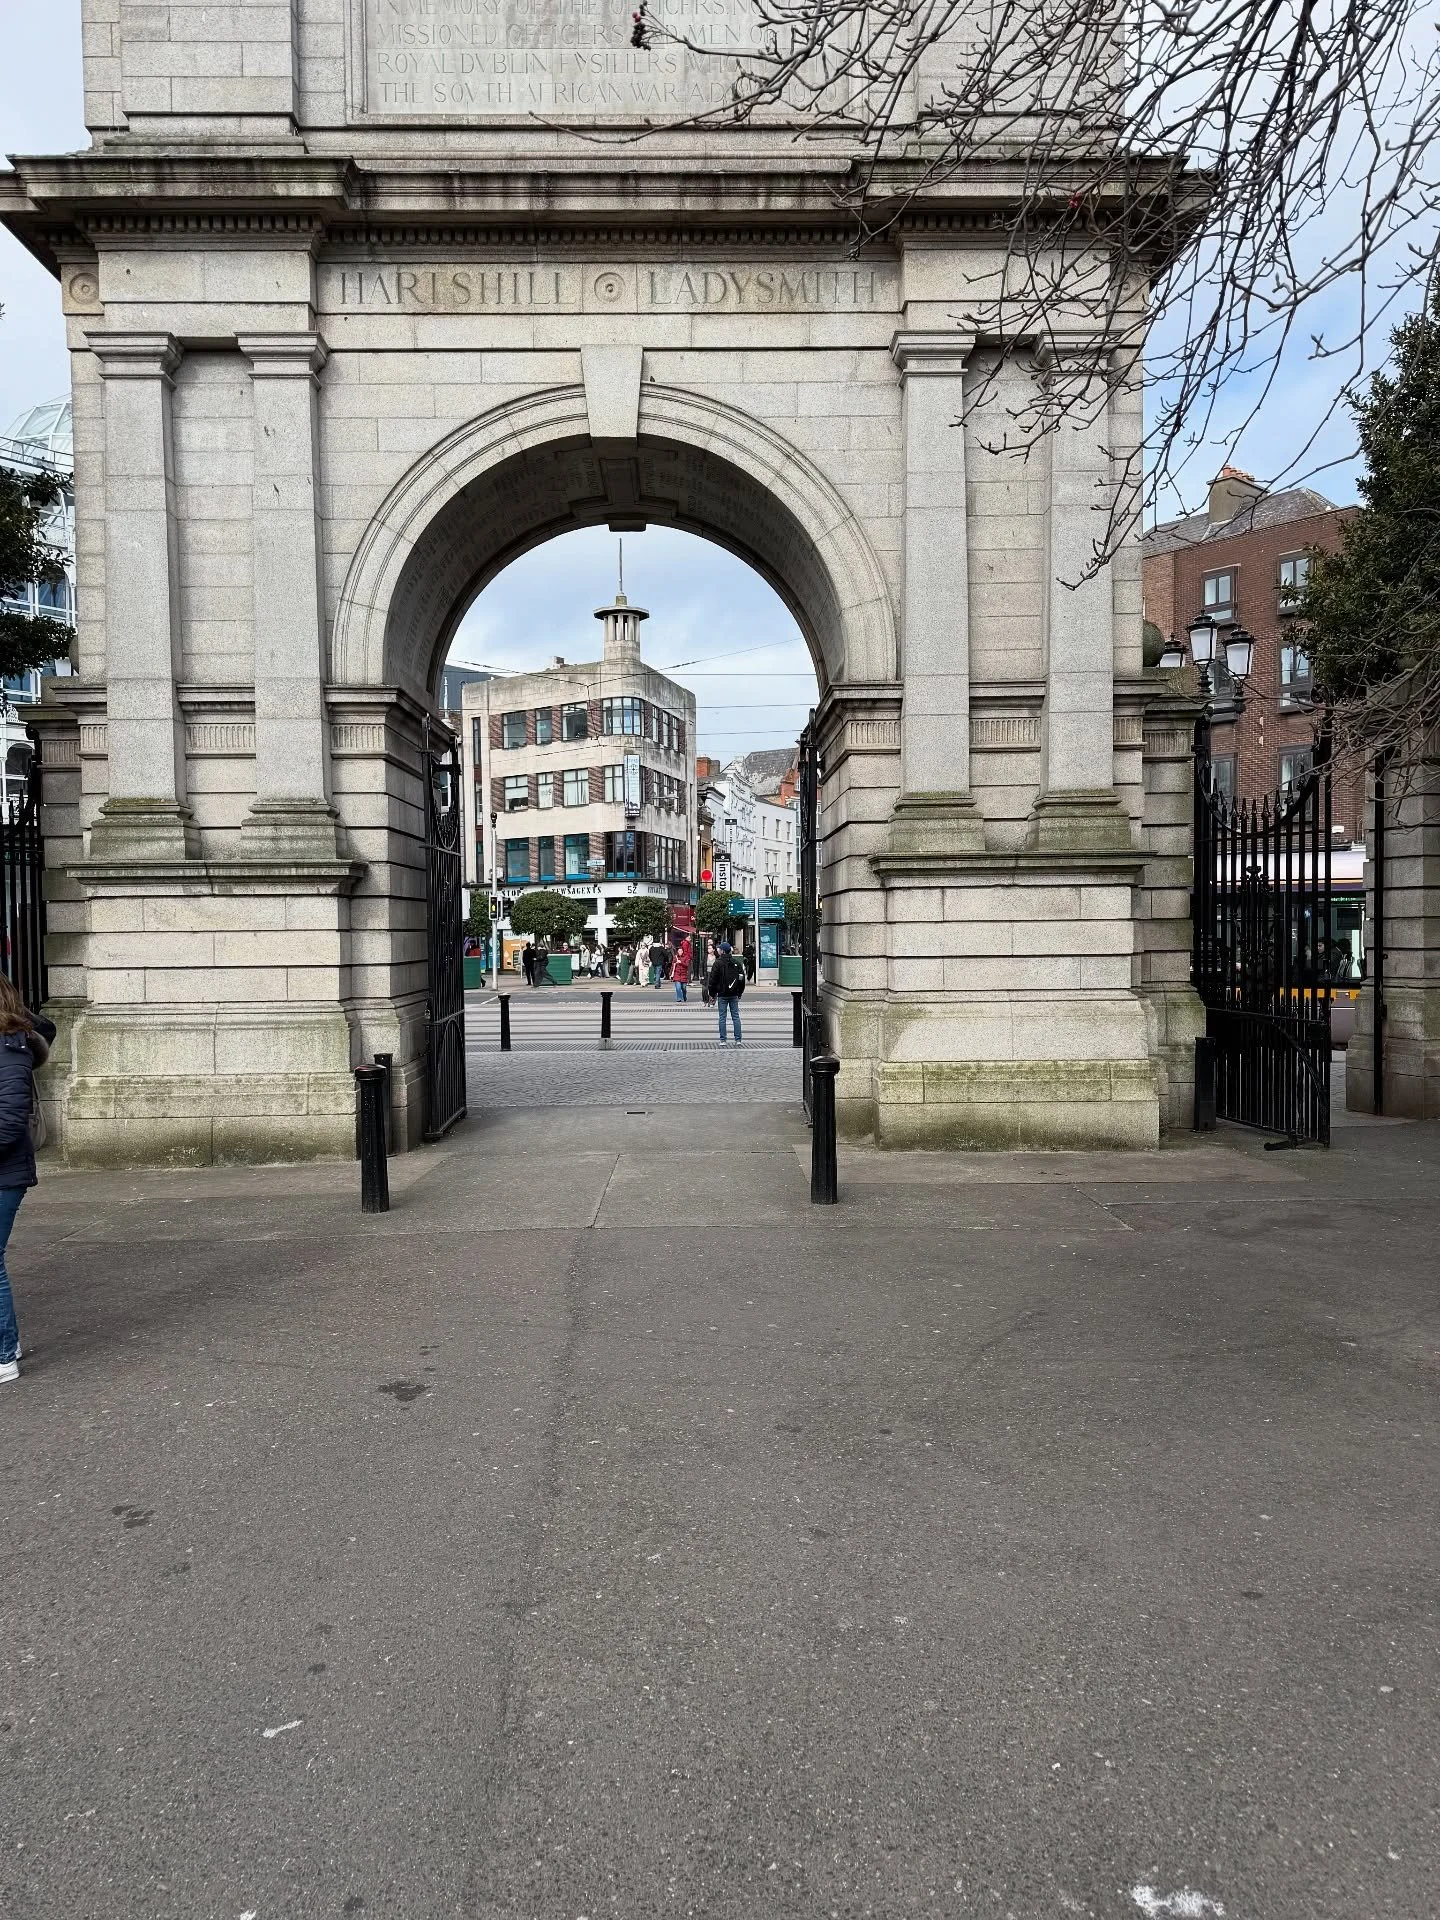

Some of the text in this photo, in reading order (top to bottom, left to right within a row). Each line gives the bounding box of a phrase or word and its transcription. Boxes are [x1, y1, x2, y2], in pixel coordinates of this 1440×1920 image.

[374, 24, 497, 45] MISSIONED
[509, 24, 625, 45] OFFICERS
[687, 24, 741, 45] MEN
[377, 52, 454, 74] ROYAL
[460, 52, 549, 74] DVBLIN
[380, 82, 423, 103] THE
[433, 82, 512, 103] SOVTH
[525, 82, 623, 103] AFRICAN
[339, 271, 576, 305] HARTSHILL
[647, 271, 876, 305] LADYSMITH
